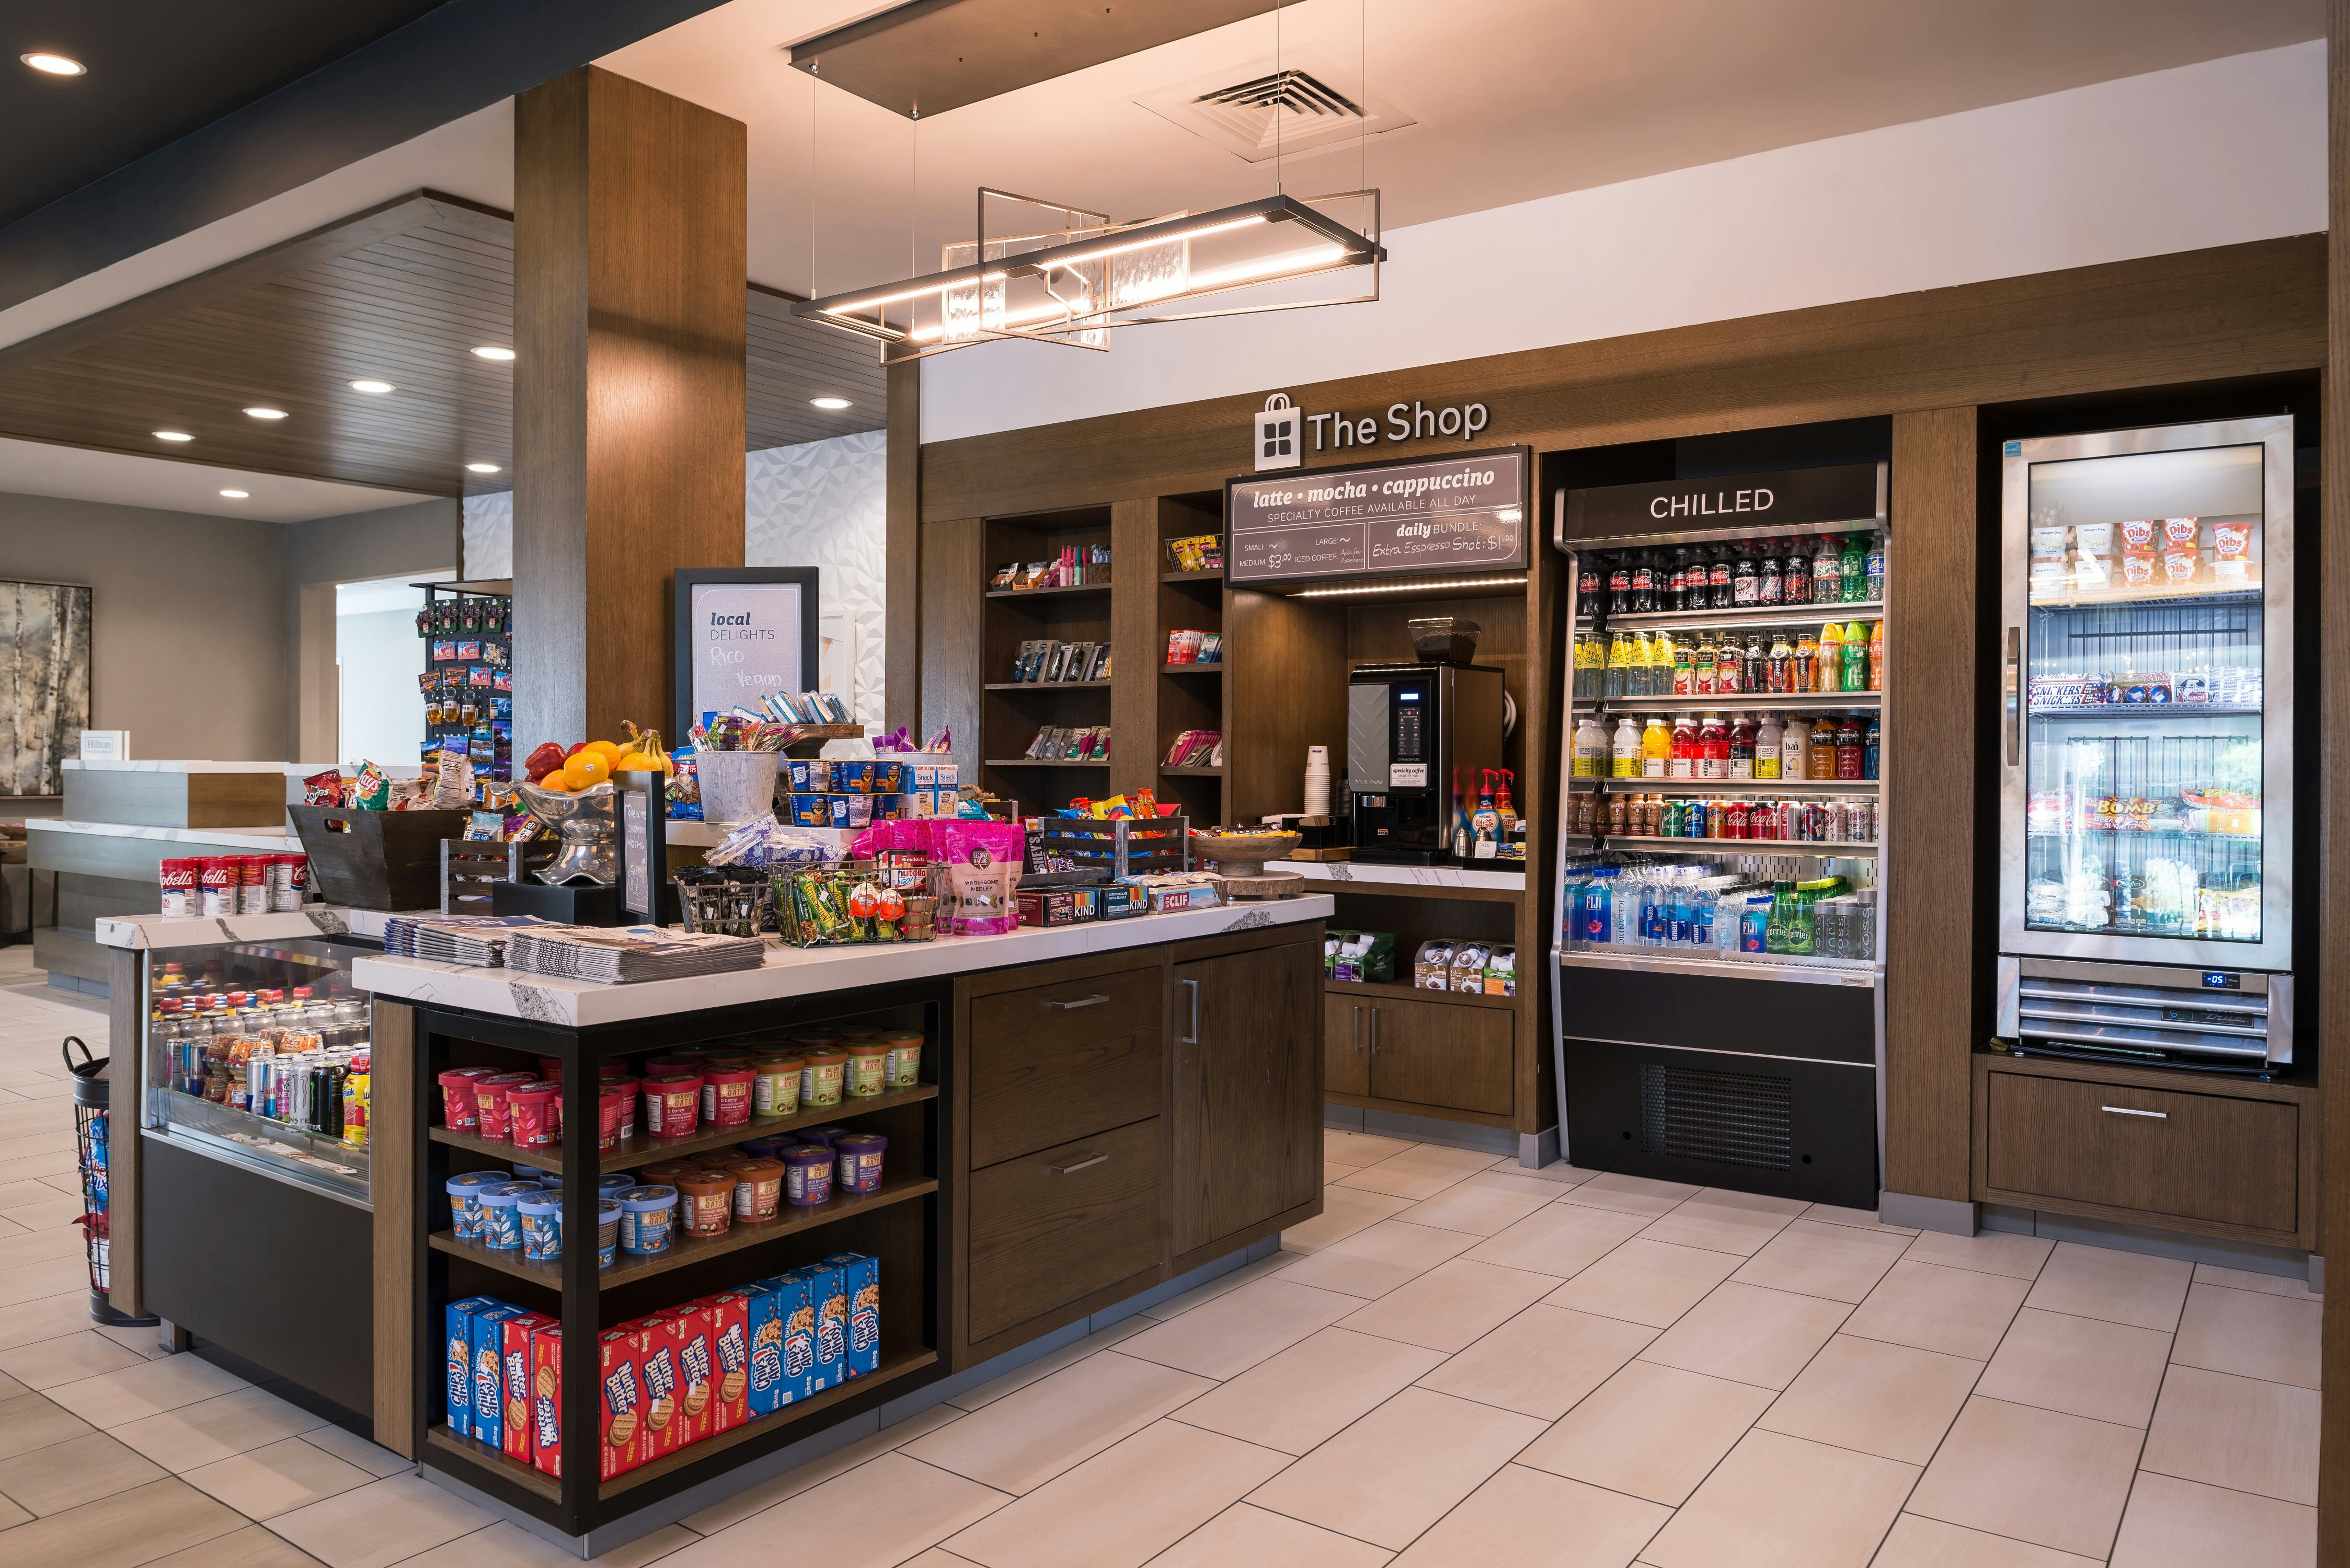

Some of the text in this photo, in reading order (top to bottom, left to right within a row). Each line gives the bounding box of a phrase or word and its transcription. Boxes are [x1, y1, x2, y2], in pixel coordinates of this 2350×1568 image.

[1307, 401, 1488, 451] The Shop
[1254, 468, 1495, 508] latte mocha cappuccino
[1268, 494, 1476, 523] SPECIALTY COFFEE AVAILABLE ALL DAY
[1650, 488, 1774, 518] CHILLED
[1396, 521, 1482, 538] daily BUNDLE:
[2127, 526, 2150, 538] Dibs
[2169, 524, 2193, 535] Dibs
[1315, 537, 1339, 546] LARGE:
[1372, 544, 1402, 557] Extra
[1404, 541, 1451, 558] Esspresso
[2218, 537, 2243, 548] Dibs
[1240, 553, 1291, 569] MEDIUM: $3.00
[1311, 553, 1339, 562] COFFEE:
[2127, 565, 2149, 575] Dibs
[711, 612, 751, 626] local
[711, 629, 775, 640] DELIGHTS
[710, 647, 744, 666] Rico
[736, 670, 781, 695] Vegan
[87, 740, 110, 748] Hilton
[1785, 741, 1798, 751] bai
[1707, 810, 1721, 818] Fanta
[2096, 800, 2157, 814] BOMB
[1129, 900, 1148, 910] KIND
[1169, 894, 1188, 907] CLIF
[1586, 896, 1602, 909] FIJI
[1074, 905, 1095, 917] KIND
[1743, 921, 1758, 933] FIJI
[706, 1200, 723, 1208] OATS
[650, 1216, 666, 1225] OATS
[851, 1288, 862, 1315] ORIGINAL
[818, 1299, 829, 1325] ORIGINAL
[785, 1310, 796, 1338] ORIGINAL
[752, 1323, 764, 1352] ORIGINAL
[854, 1320, 870, 1352] Chips
[692, 1335, 709, 1377] Nutter
[718, 1334, 738, 1372] Butter
[821, 1331, 835, 1364] Chips
[656, 1347, 674, 1390] Nutter
[682, 1346, 701, 1384] Butter
[788, 1344, 803, 1377] Chips
[507, 1356, 521, 1401] Butter
[617, 1361, 636, 1404] Nutter
[645, 1359, 666, 1398] Butter
[755, 1356, 771, 1390] Chips
[606, 1374, 628, 1413] Butter
[537, 1399, 550, 1447] Nutter
